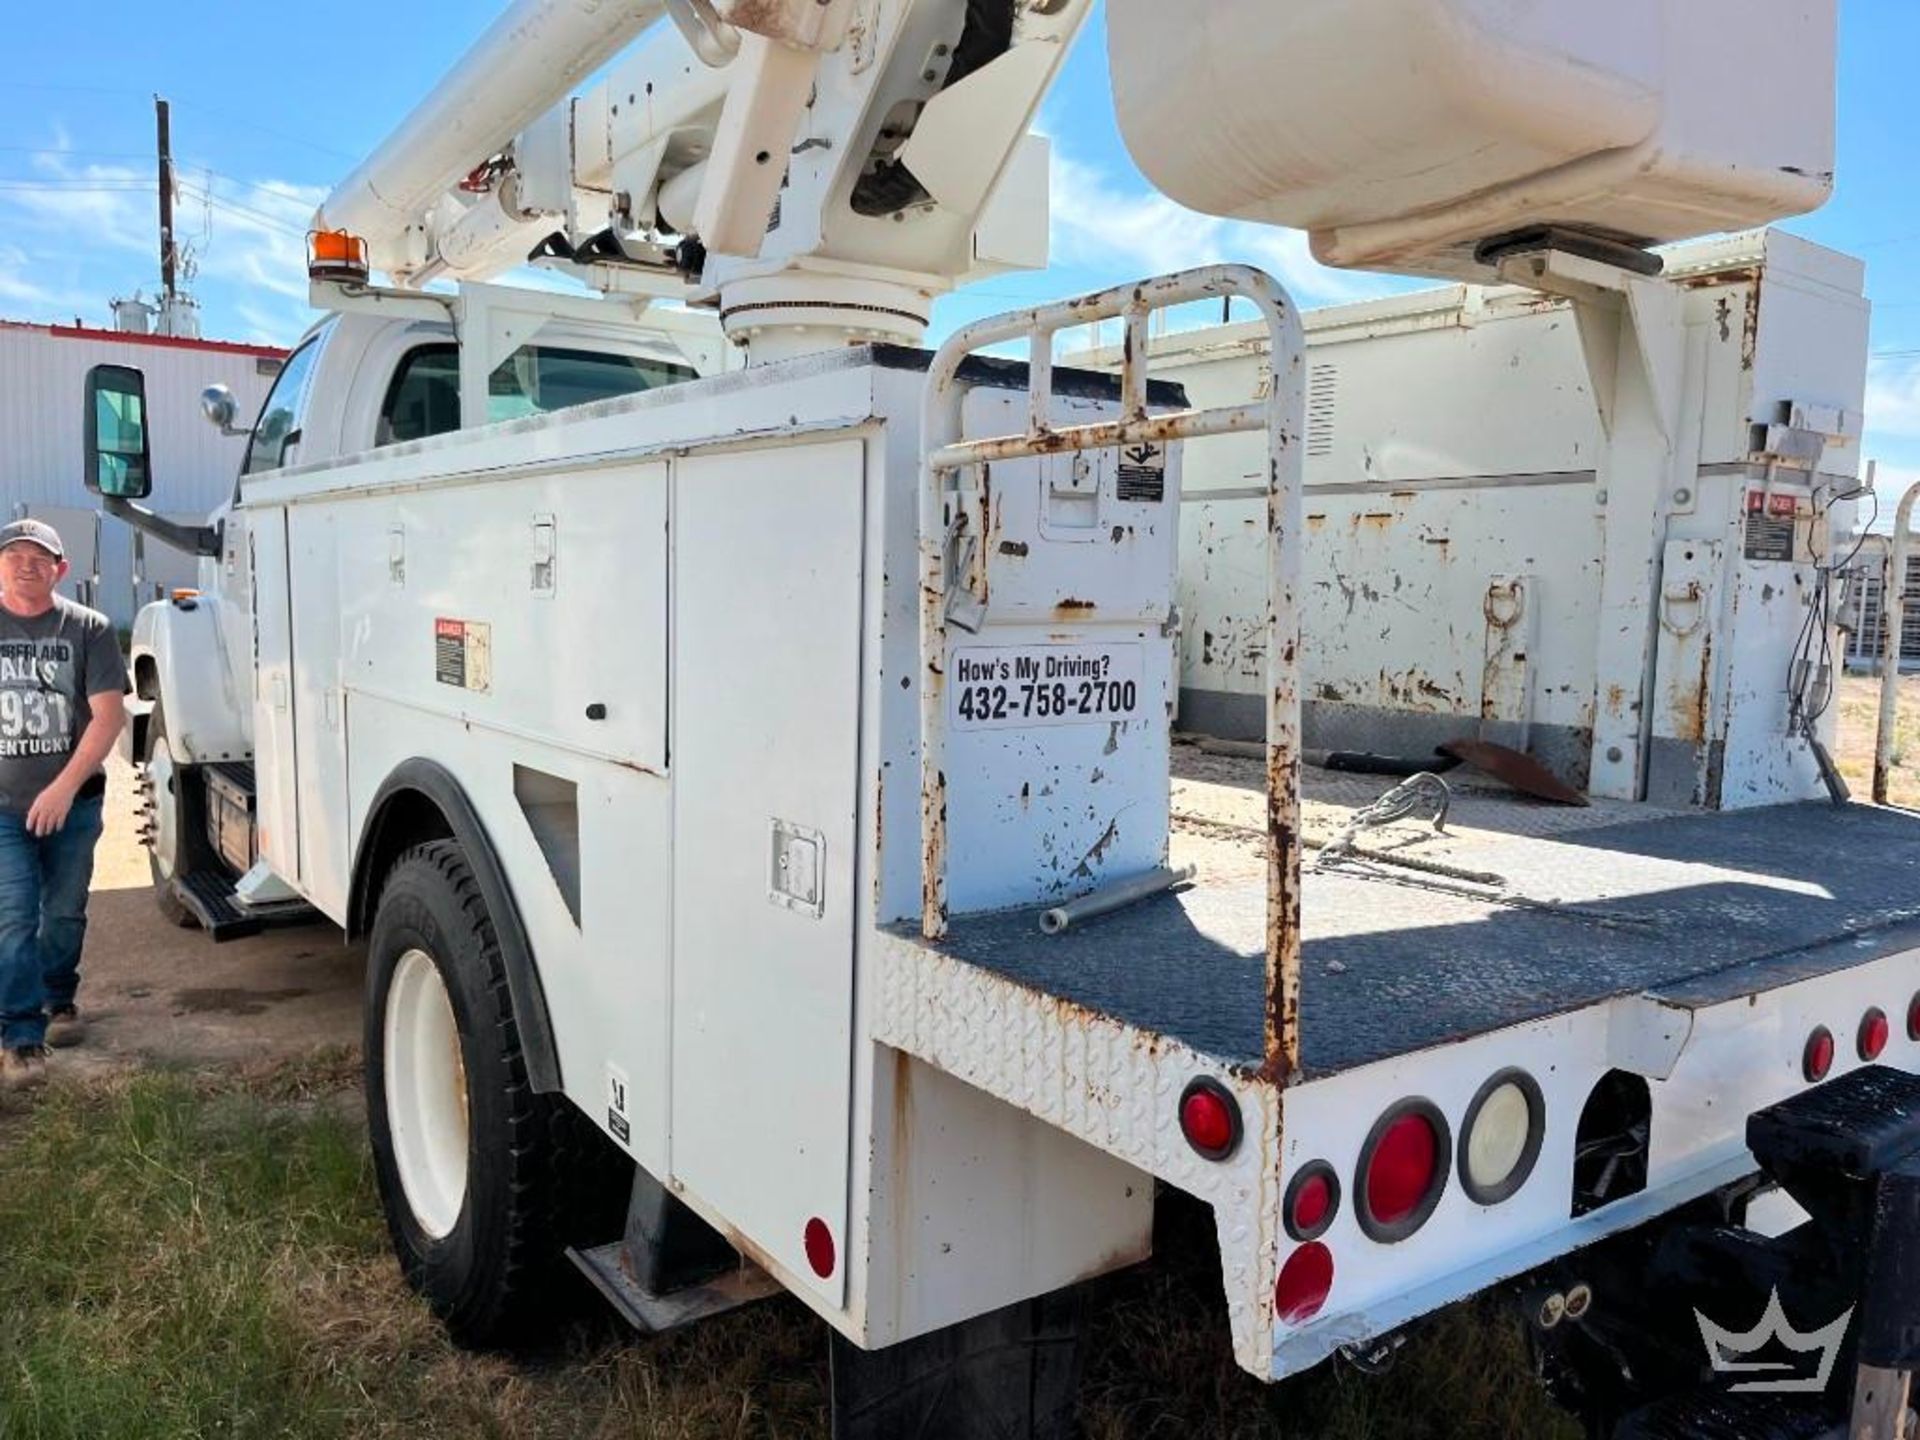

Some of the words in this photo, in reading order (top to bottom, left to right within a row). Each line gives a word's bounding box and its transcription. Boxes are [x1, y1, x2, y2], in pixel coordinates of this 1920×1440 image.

[1, 657, 58, 684] ALLS
[958, 657, 1010, 682] How's
[1015, 656, 1040, 683] My
[1045, 654, 1110, 680] Driving?
[1, 690, 68, 736] 931
[958, 680, 1136, 721] 432-758-2700
